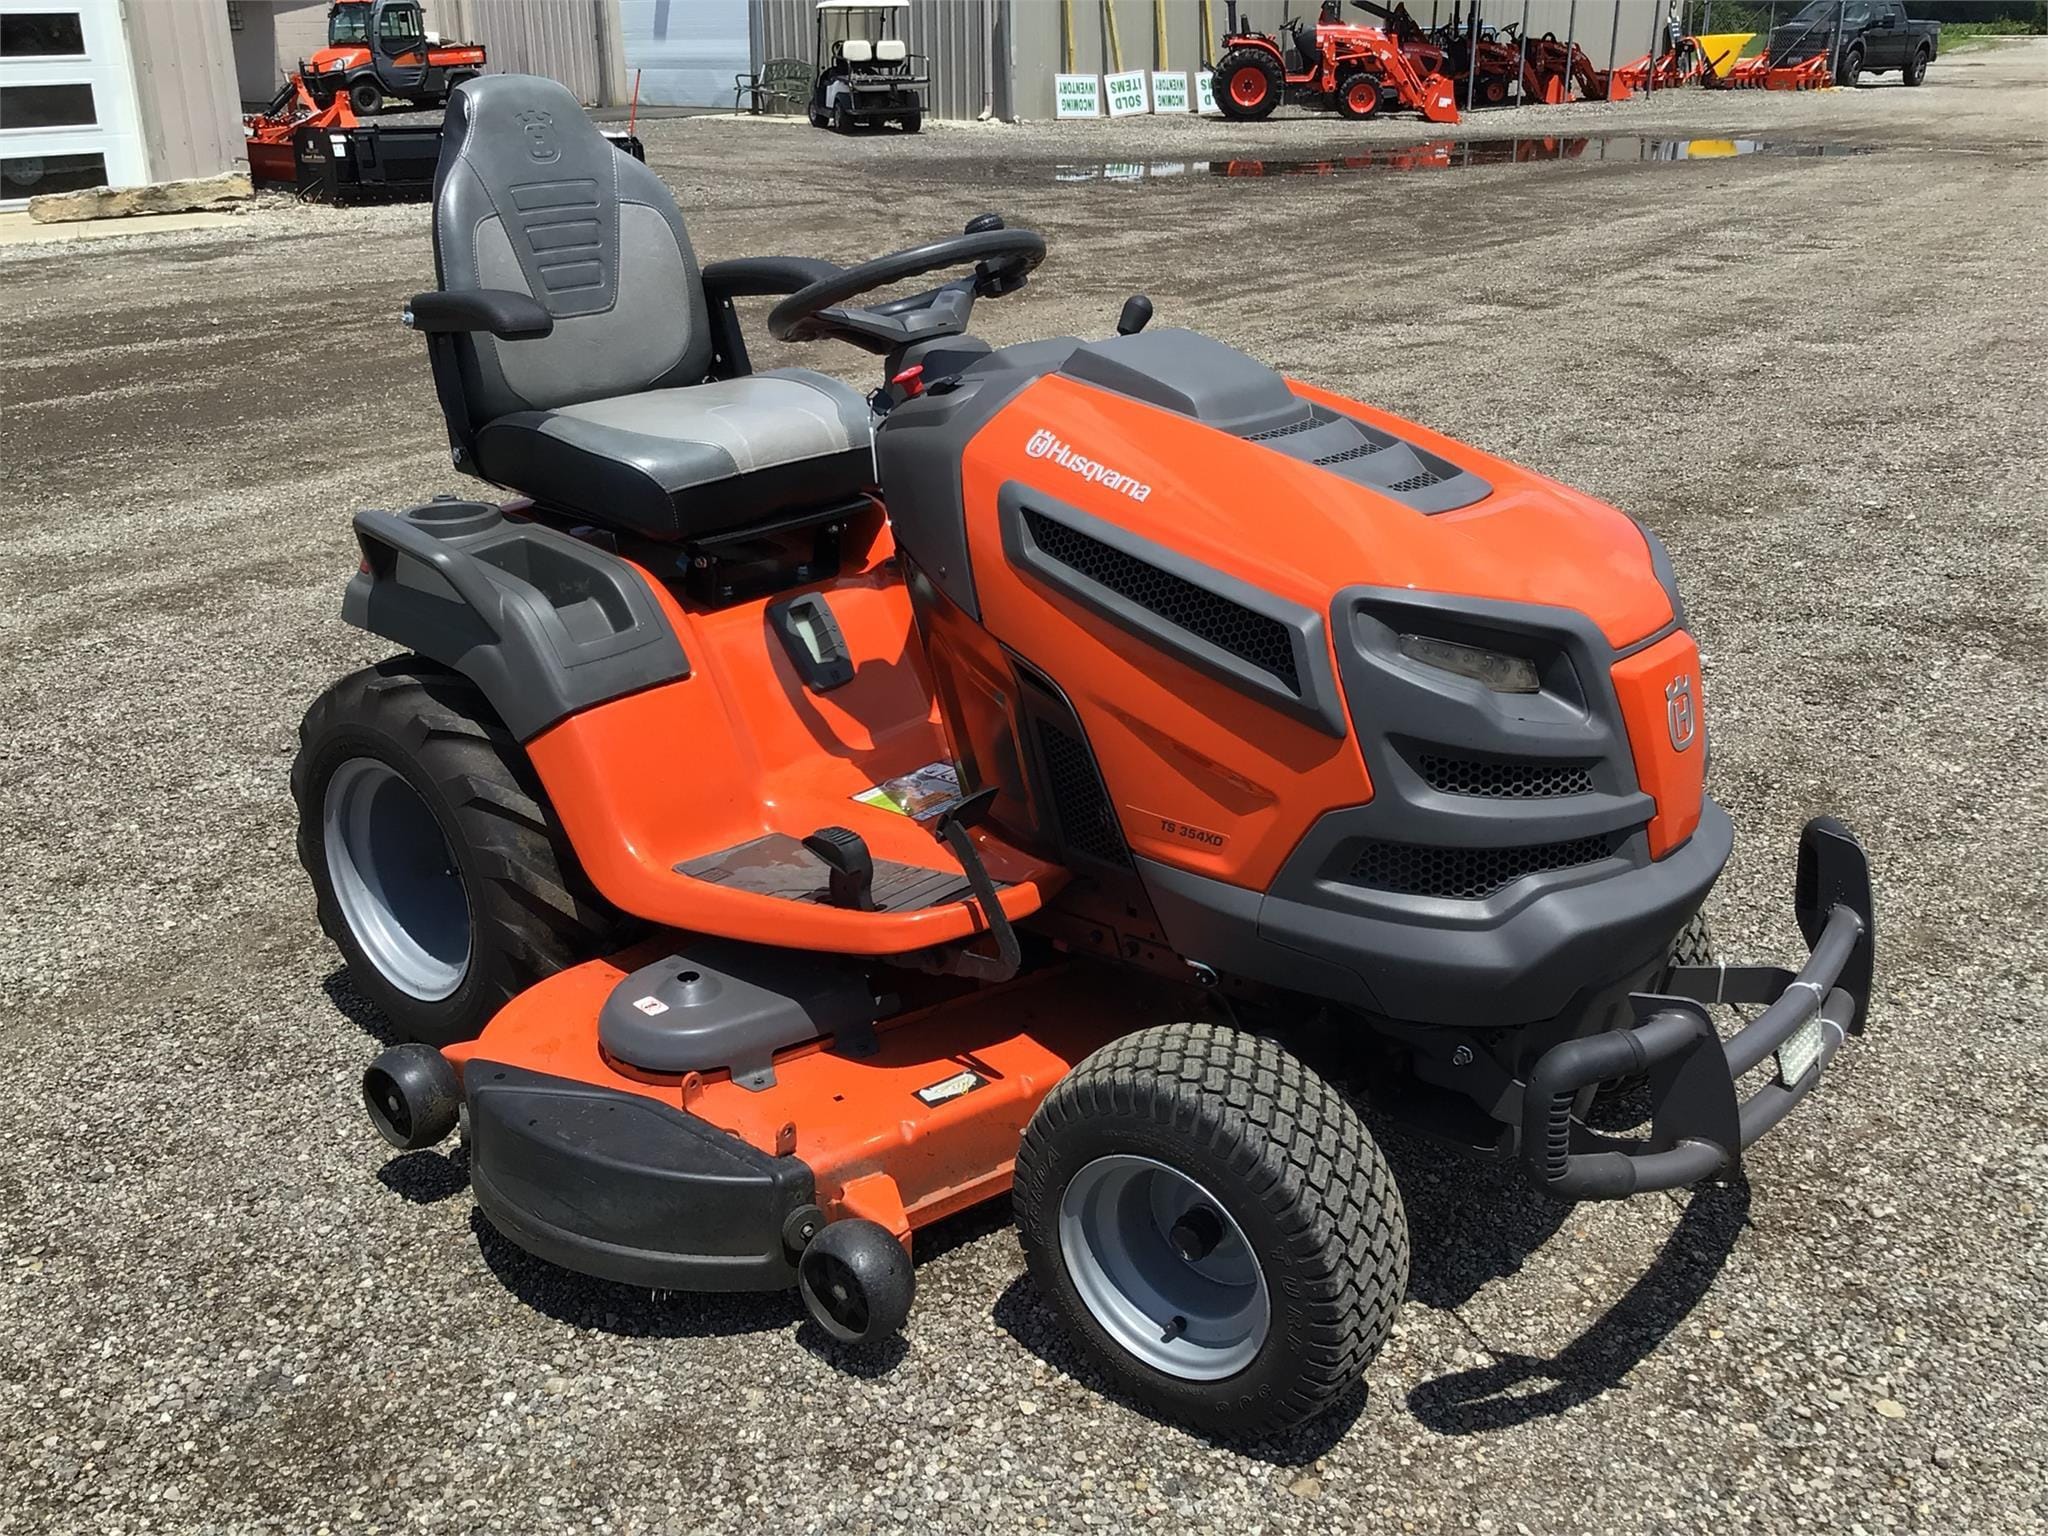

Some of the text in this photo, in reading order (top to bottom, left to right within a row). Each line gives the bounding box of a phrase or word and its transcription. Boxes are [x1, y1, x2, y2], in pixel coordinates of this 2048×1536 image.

[1059, 82, 1096, 94] INVENTORY
[1111, 78, 1142, 94] ITEMS
[1155, 79, 1185, 91] INVENTORY
[1062, 99, 1095, 111] INCOMING
[1115, 95, 1142, 110] SOLD
[1158, 95, 1185, 107] INCOMING
[1046, 440, 1152, 502] Husqvarna
[1160, 820, 1224, 847] TS 354XD
